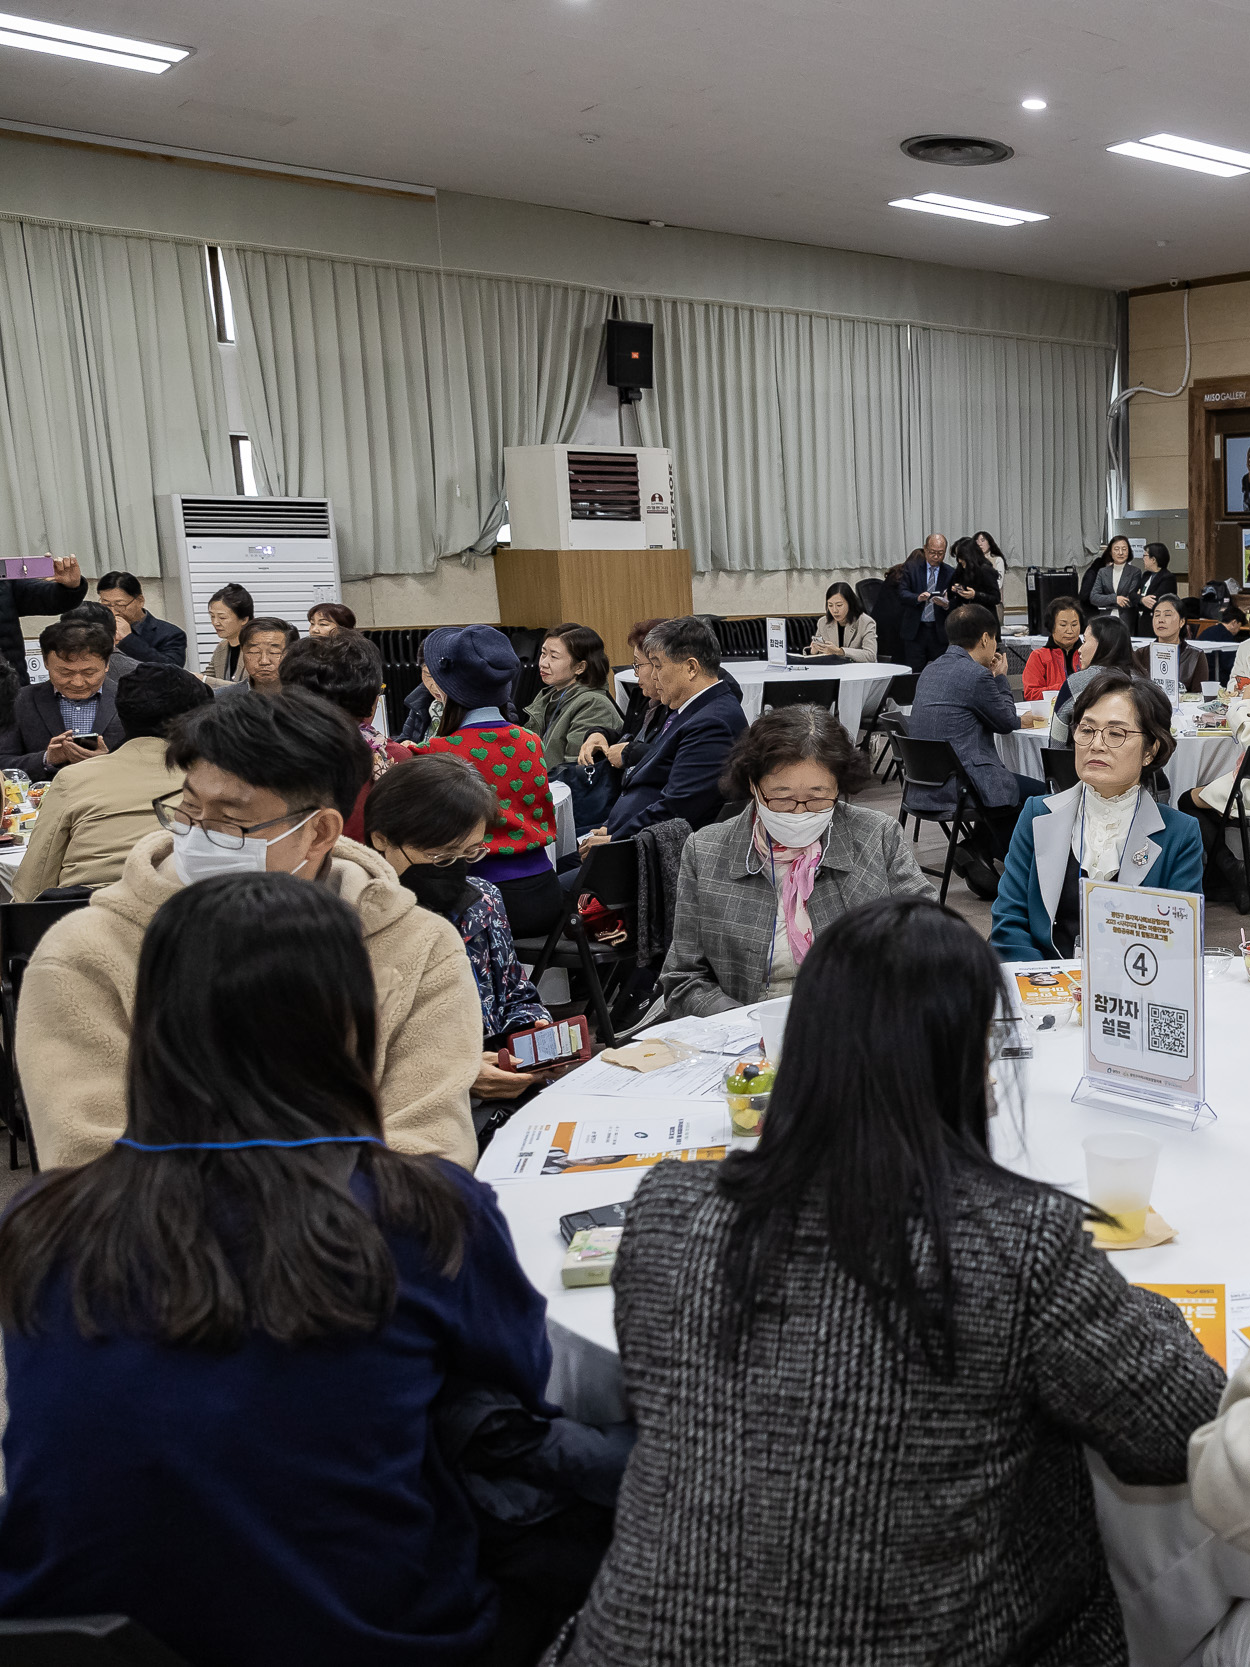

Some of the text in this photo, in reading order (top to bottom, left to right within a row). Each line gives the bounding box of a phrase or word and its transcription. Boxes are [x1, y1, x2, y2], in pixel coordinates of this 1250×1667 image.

[1204, 391, 1246, 402] MISO GALLERY
[668, 464, 676, 541] REZNOR
[1094, 994, 1140, 1020] 참가자
[1102, 1017, 1130, 1040] 설문
